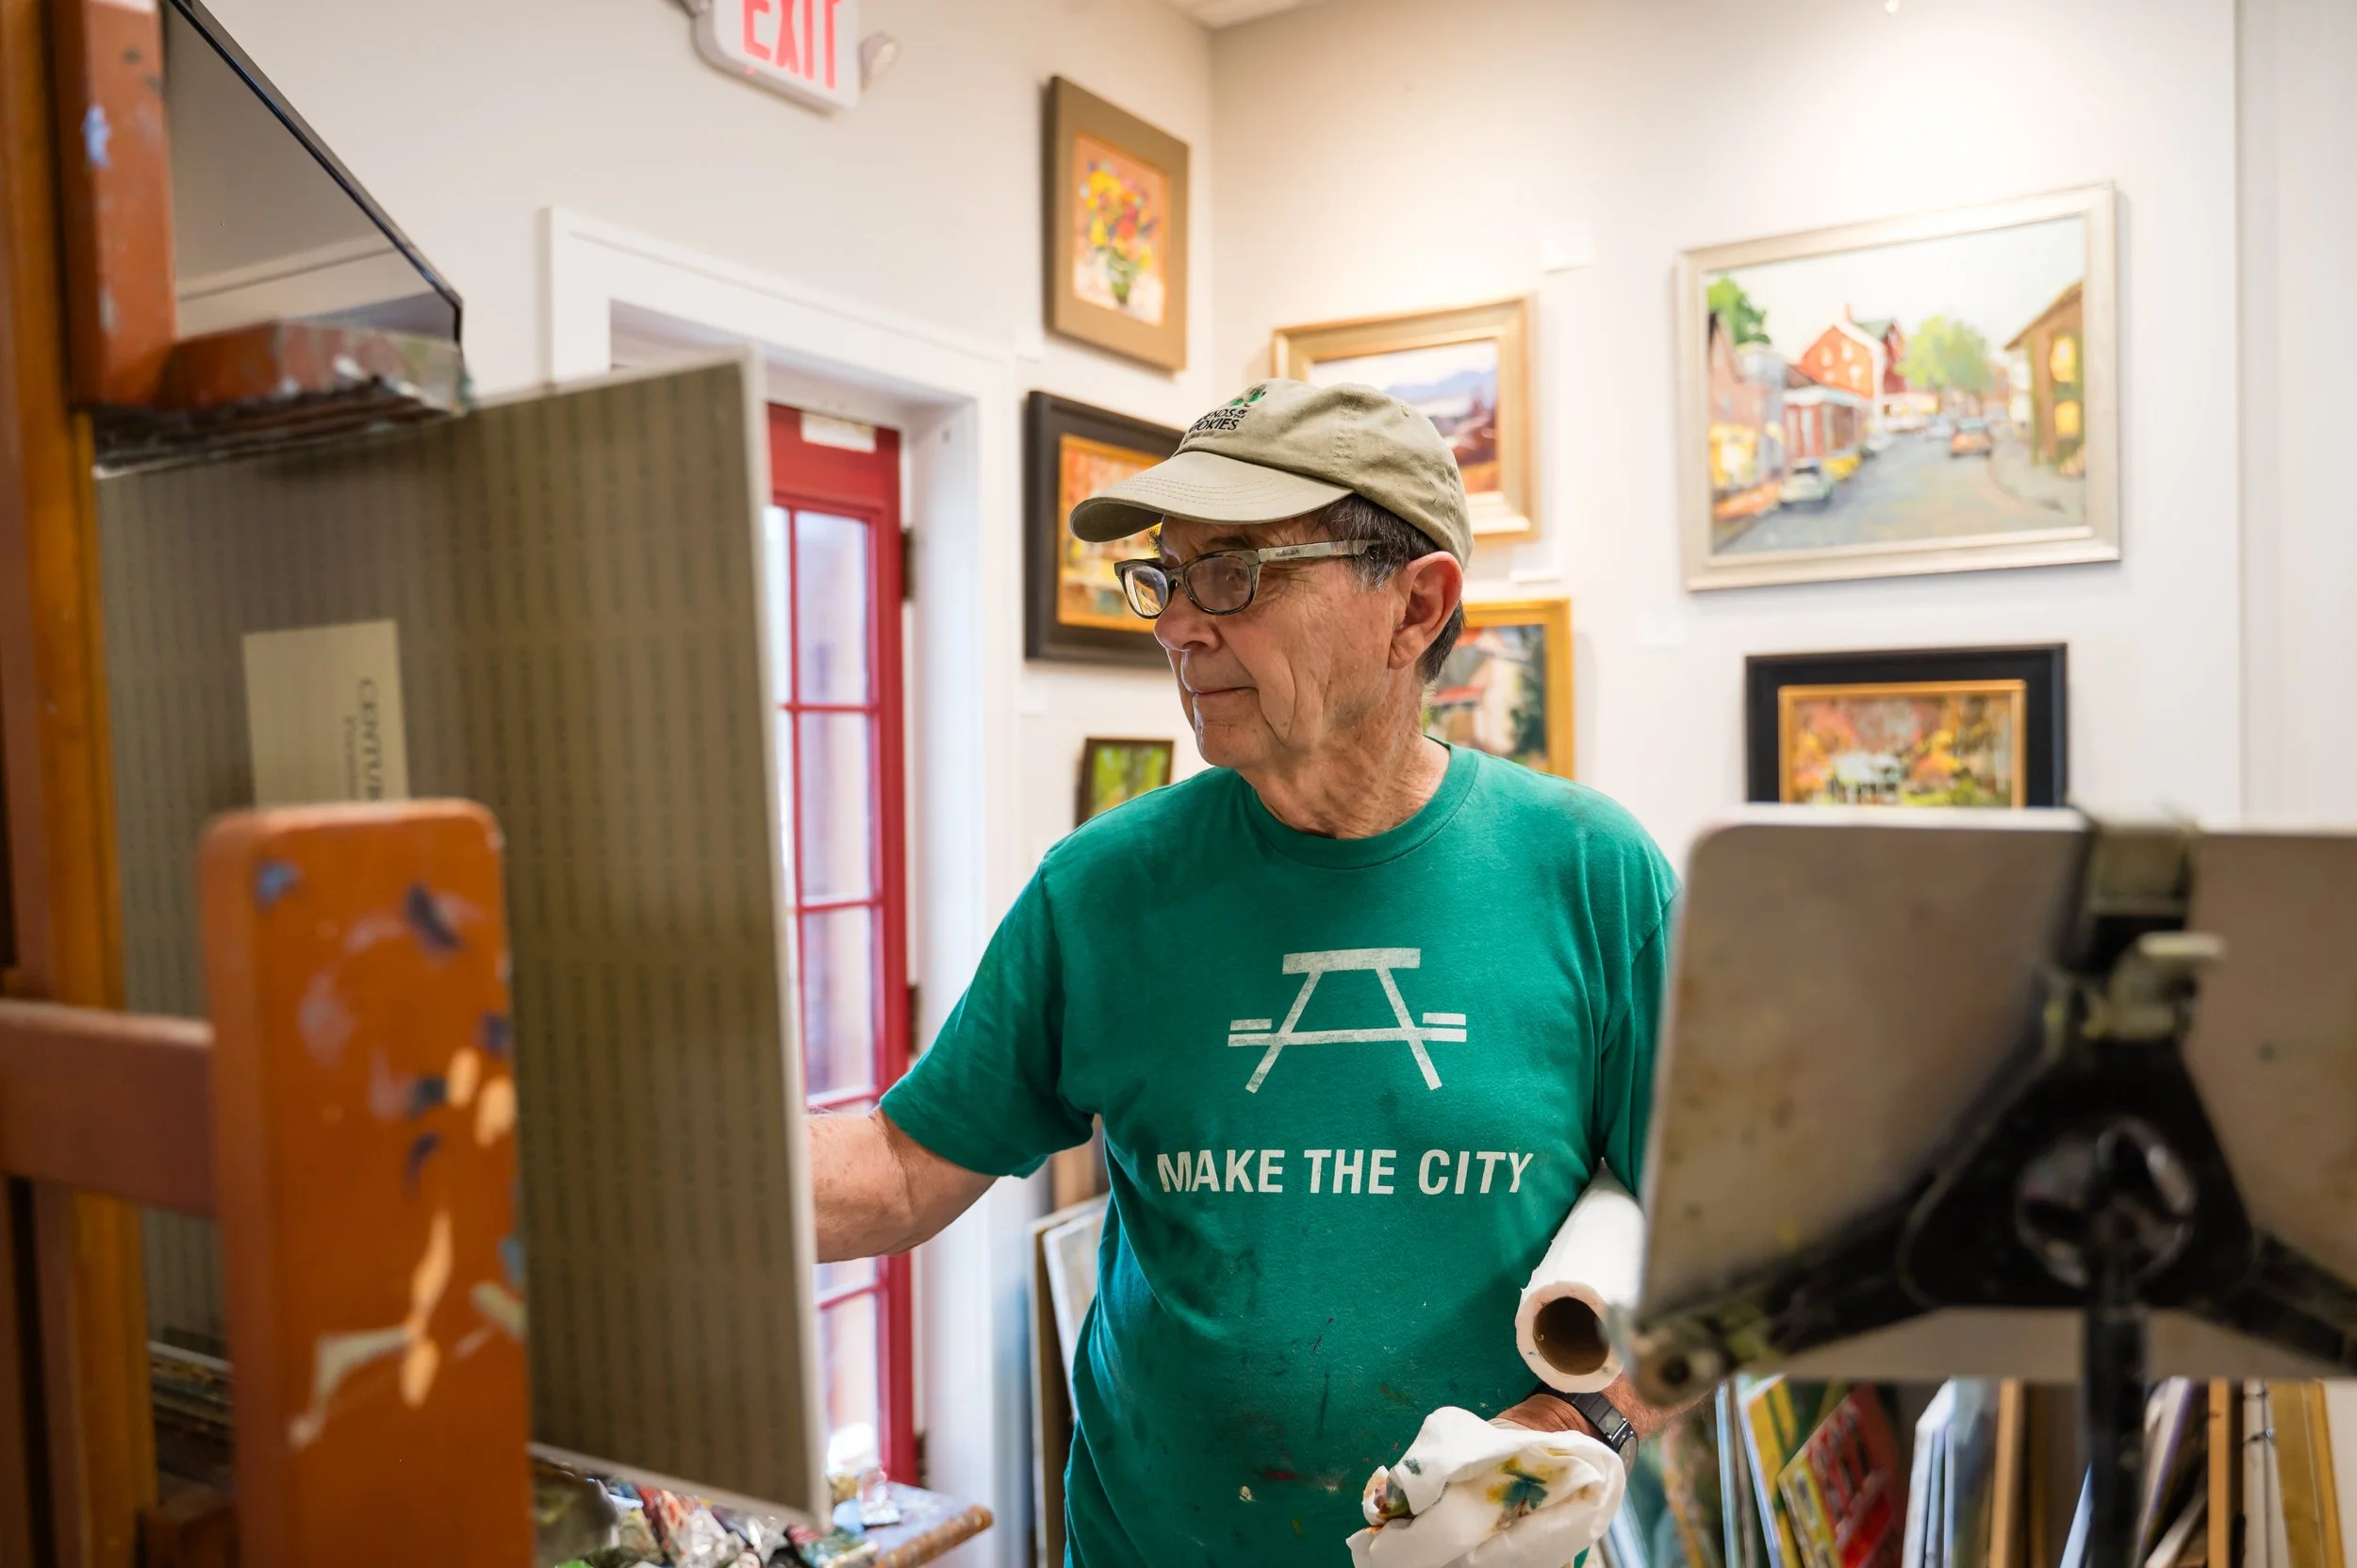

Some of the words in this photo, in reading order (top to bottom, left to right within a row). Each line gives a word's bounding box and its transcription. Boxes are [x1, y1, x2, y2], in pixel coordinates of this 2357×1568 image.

[743, 0, 842, 90] EXIT
[1156, 1148, 1285, 1194] MAKE
[1304, 1148, 1397, 1195] THE
[1417, 1147, 1534, 1195] CITY
